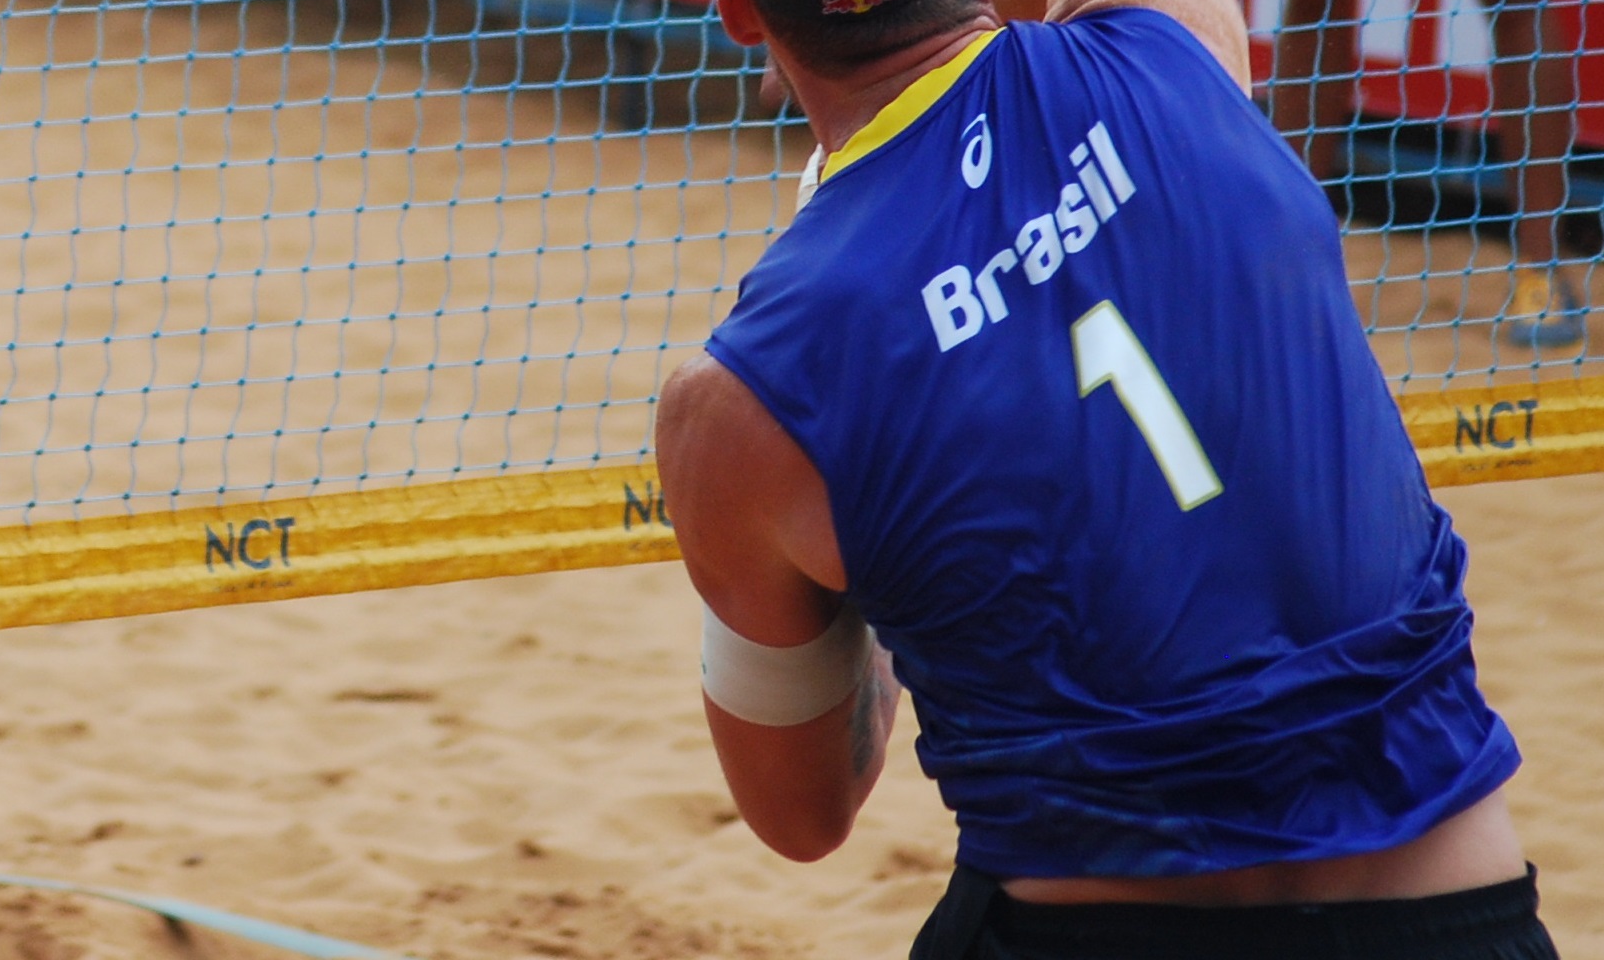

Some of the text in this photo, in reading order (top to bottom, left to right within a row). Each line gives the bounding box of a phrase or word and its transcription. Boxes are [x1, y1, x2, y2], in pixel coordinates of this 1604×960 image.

[921, 120, 1136, 353] Brasil
[1070, 298, 1225, 513] 1
[1454, 398, 1538, 454] NCT
[204, 516, 295, 573] NCT
